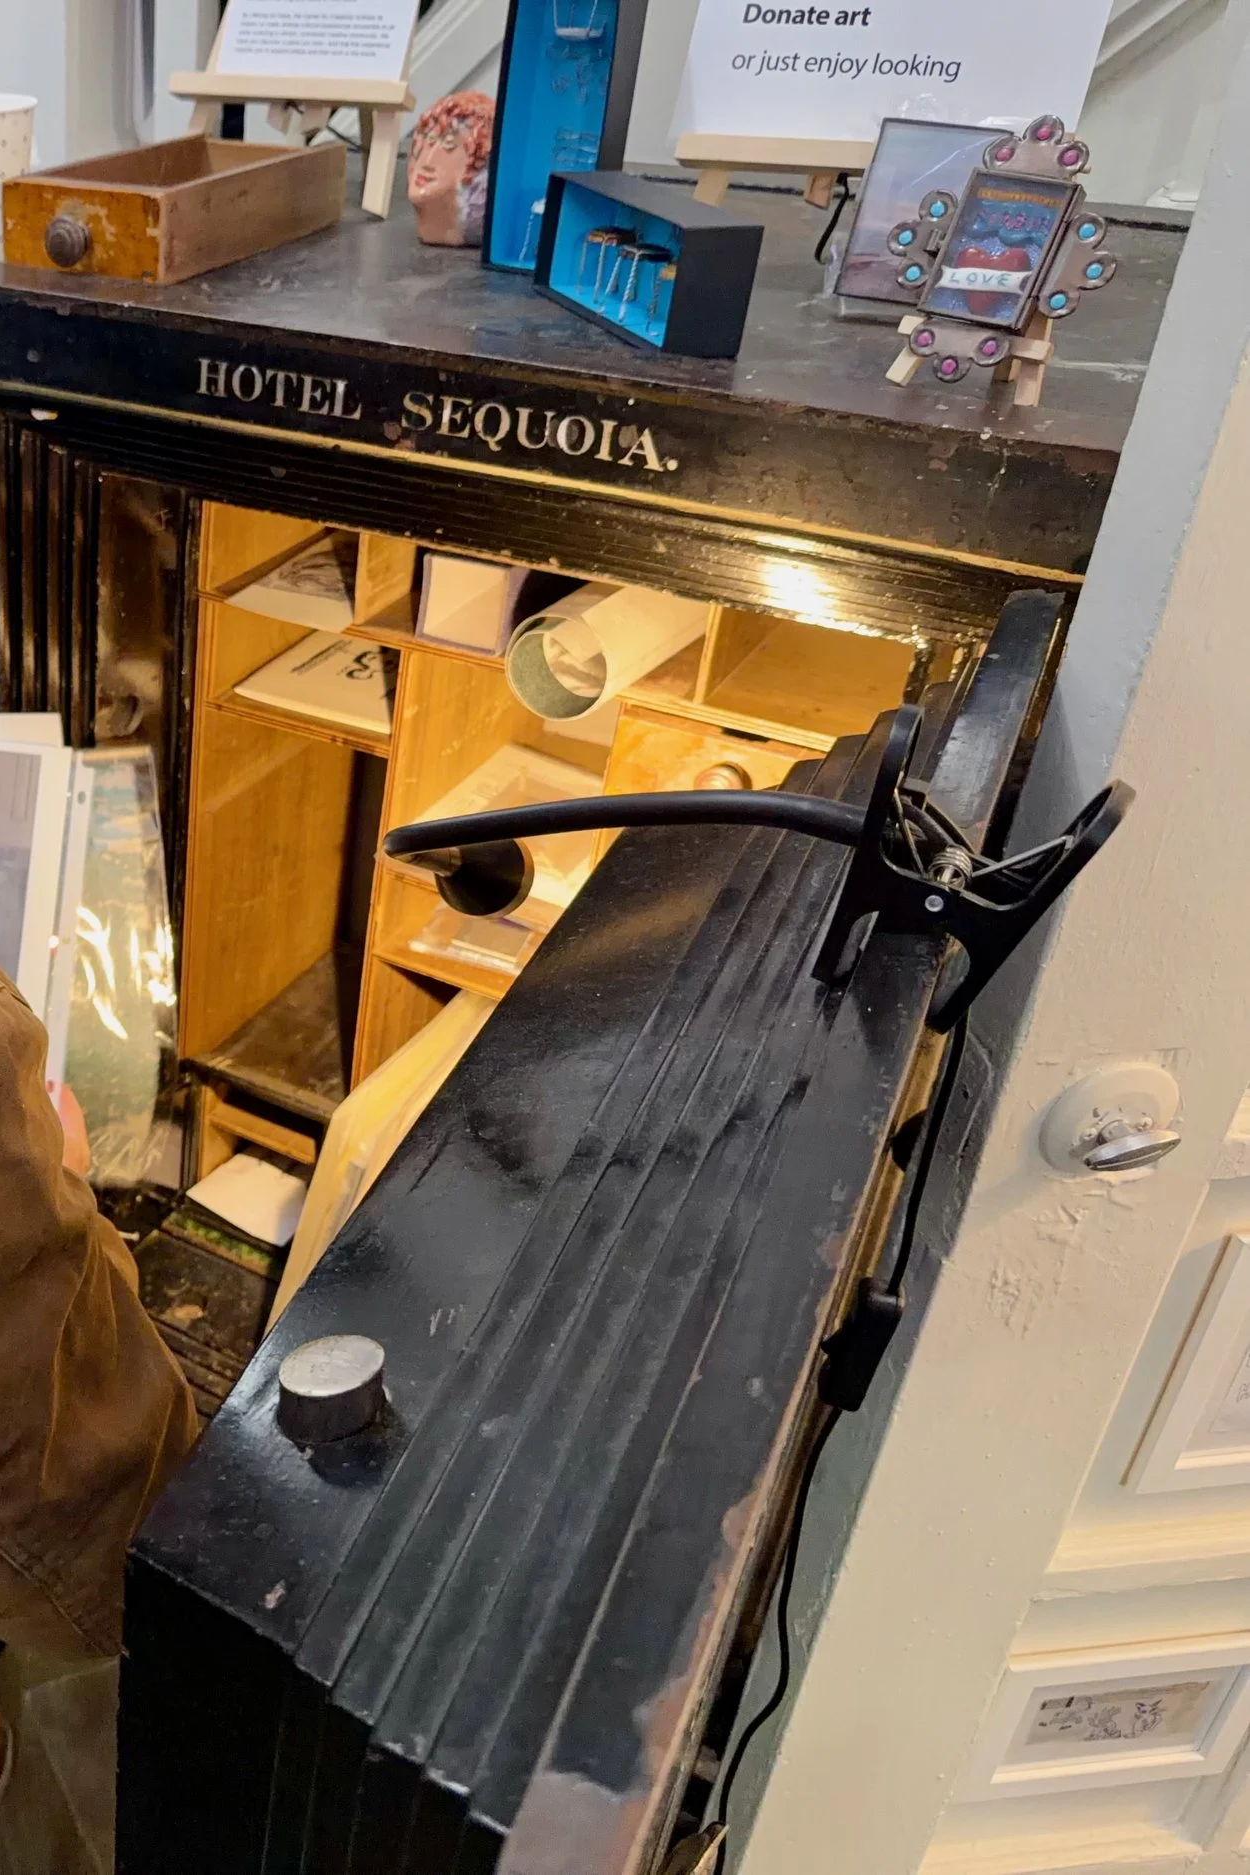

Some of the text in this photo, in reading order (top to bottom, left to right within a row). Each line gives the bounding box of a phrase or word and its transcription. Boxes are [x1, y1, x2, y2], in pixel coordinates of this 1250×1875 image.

[742, 2, 872, 27] Donate art
[732, 50, 962, 83] or just enjoy looking
[949, 272, 1012, 287] LOVE
[196, 358, 678, 473] HOTEL SEQUOIA.
